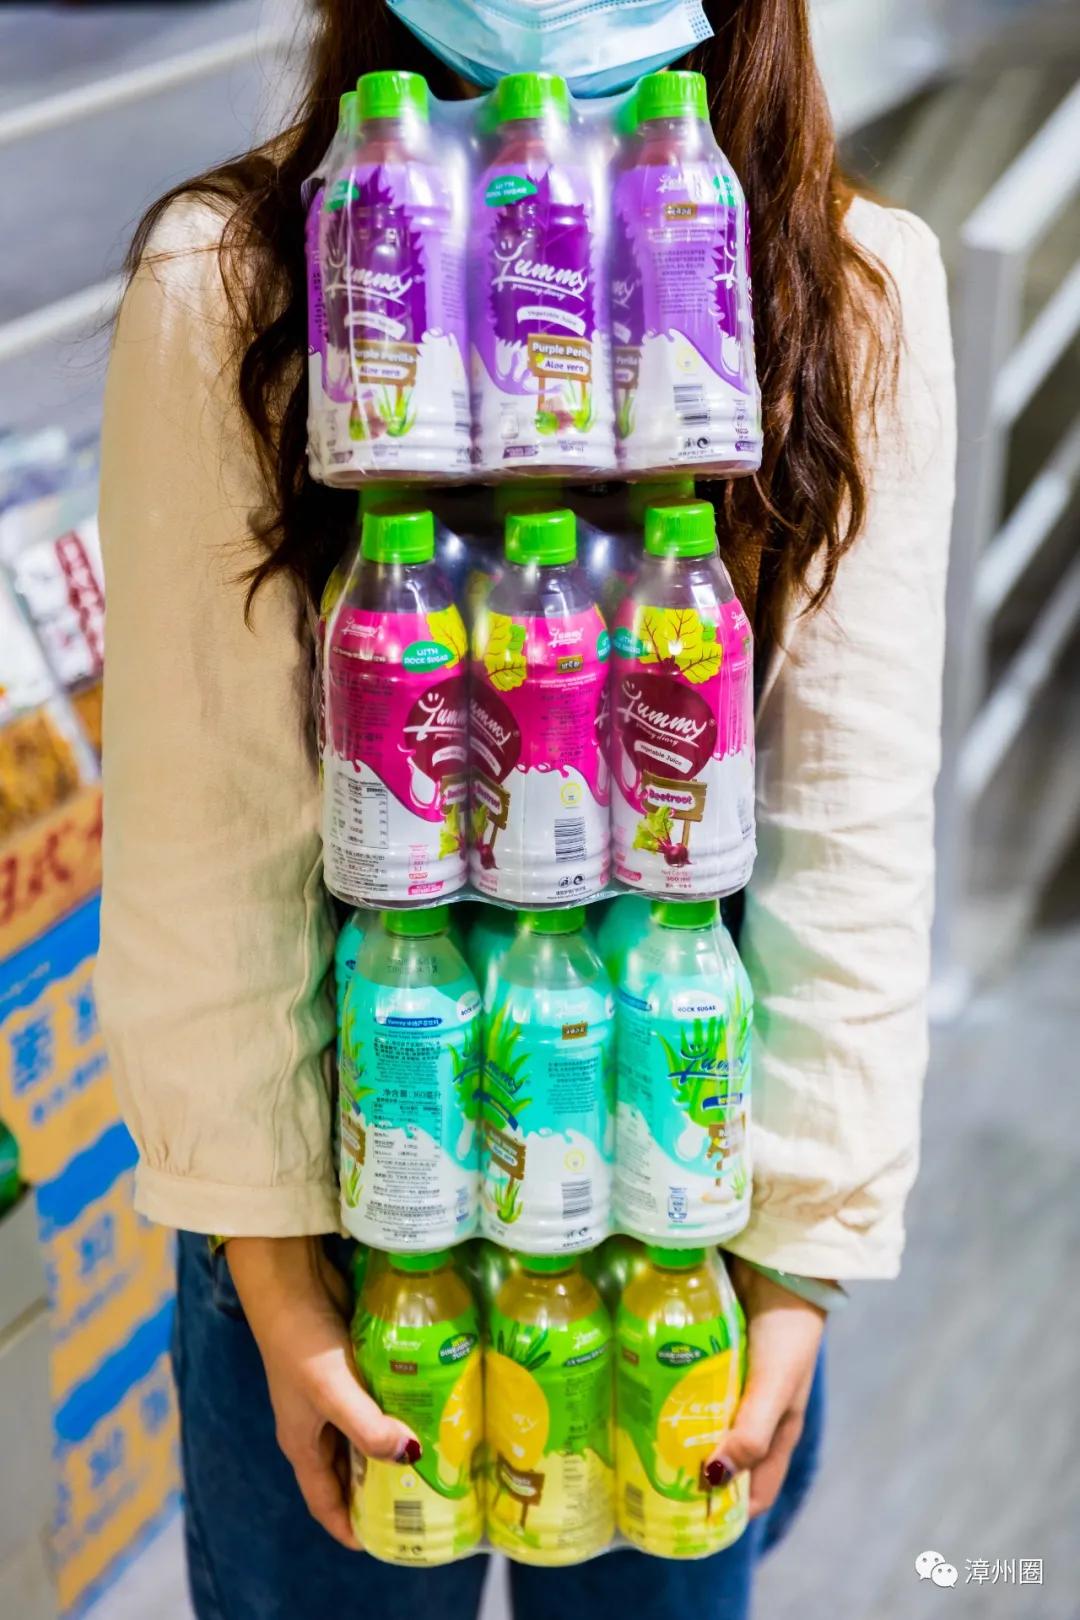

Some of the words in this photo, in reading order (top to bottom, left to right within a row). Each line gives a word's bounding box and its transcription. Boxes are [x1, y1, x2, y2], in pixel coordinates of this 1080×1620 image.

[491, 239, 588, 303] Yummy
[532, 341, 564, 356] Purple
[545, 360, 564, 369] Aloe
[567, 364, 584, 372] vera
[416, 648, 439, 657] WITH
[404, 656, 427, 665] ROCK
[617, 680, 707, 749] Yummy
[648, 789, 693, 805] Beetroot
[696, 1004, 716, 1012] SUGAR
